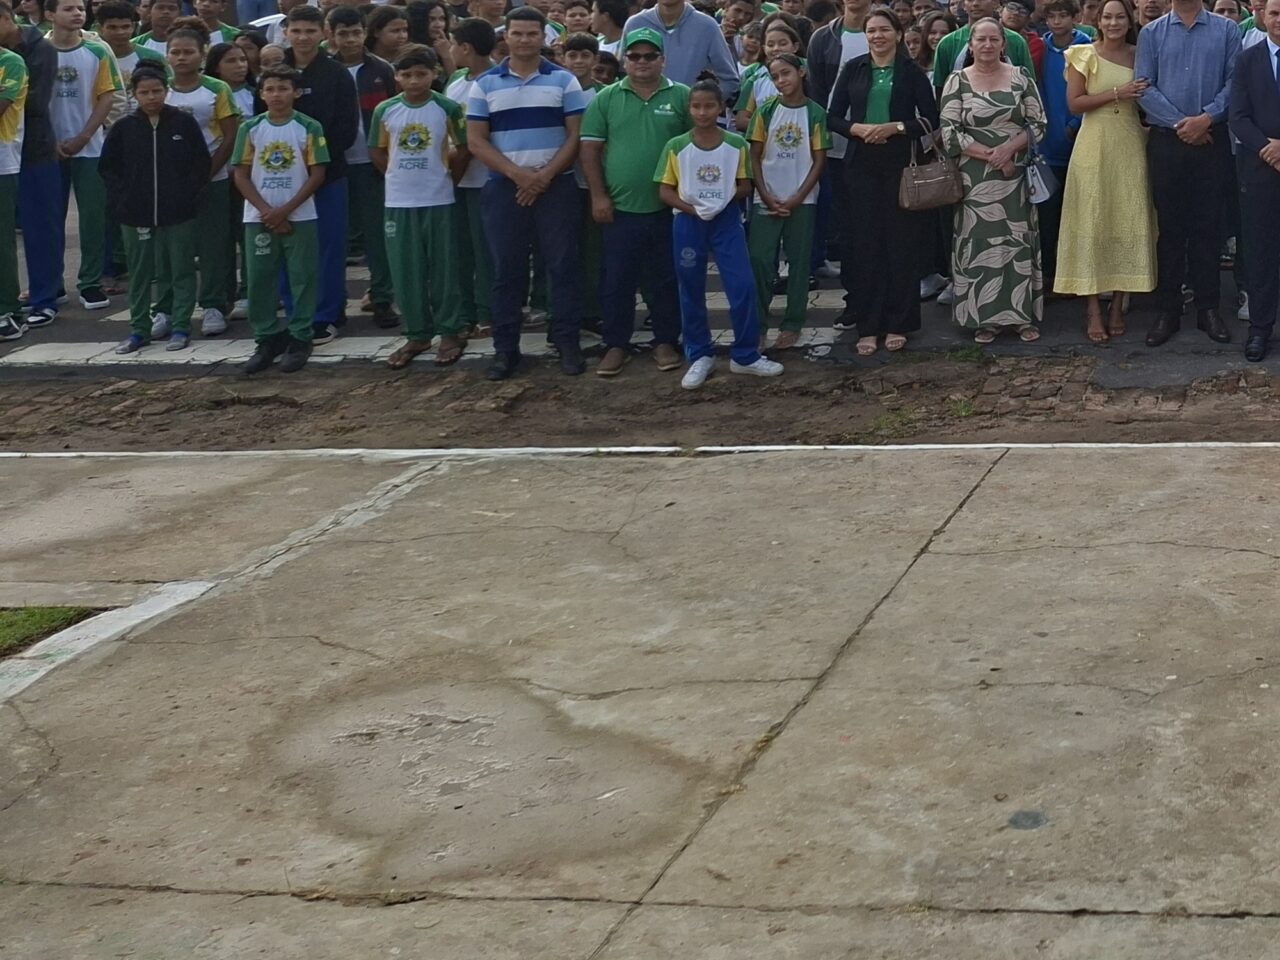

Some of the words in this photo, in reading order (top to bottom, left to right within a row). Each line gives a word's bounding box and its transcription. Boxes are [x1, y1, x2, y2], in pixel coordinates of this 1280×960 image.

[398, 161, 429, 170] ACRE
[261, 180, 292, 189] ACRE
[699, 191, 725, 200] ACRE
